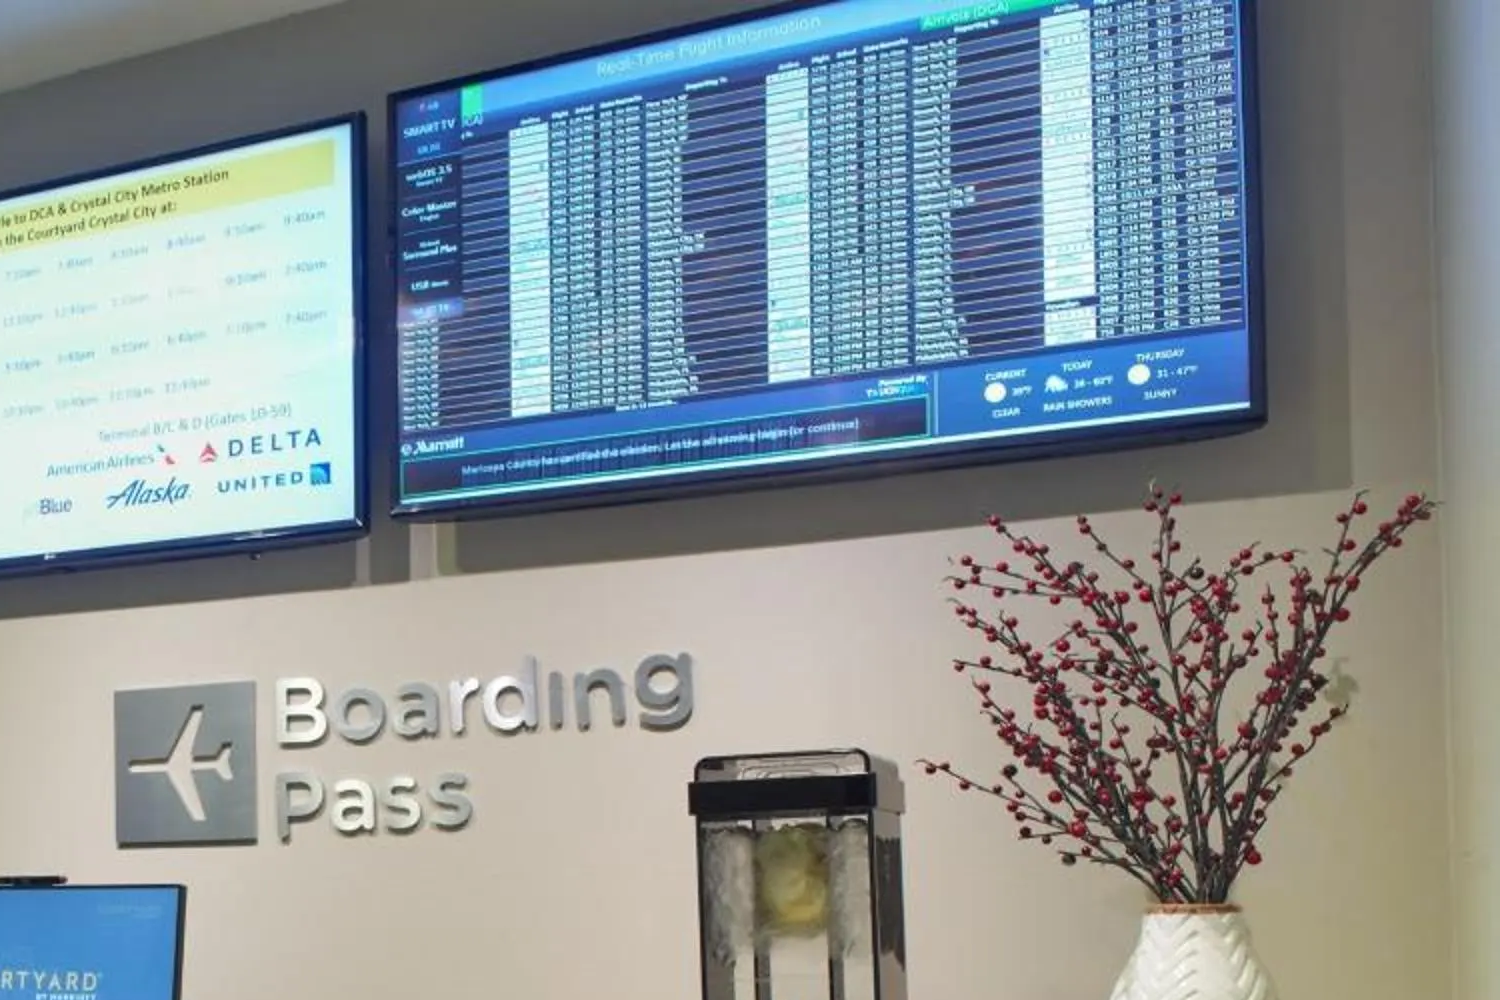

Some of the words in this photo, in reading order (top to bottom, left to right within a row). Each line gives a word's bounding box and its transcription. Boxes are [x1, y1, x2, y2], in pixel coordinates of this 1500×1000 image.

[14, 213, 27, 225] to
[29, 206, 54, 222] DCA
[57, 202, 67, 216] &
[70, 192, 111, 213] Crystal
[115, 188, 139, 204] City
[141, 181, 180, 199] Metro
[183, 169, 229, 189] Station
[5, 231, 24, 245] the
[27, 216, 85, 242] Courtyard
[88, 210, 130, 230] Crystal
[133, 204, 157, 219] City
[160, 200, 177, 214] at:
[227, 427, 322, 458] DELTA
[46, 460, 106, 478] American
[107, 453, 155, 469] Airlines
[106, 476, 191, 510] Alaska
[216, 470, 304, 494] UNITED
[275, 651, 695, 749] Boarding
[275, 772, 475, 846] Pass
